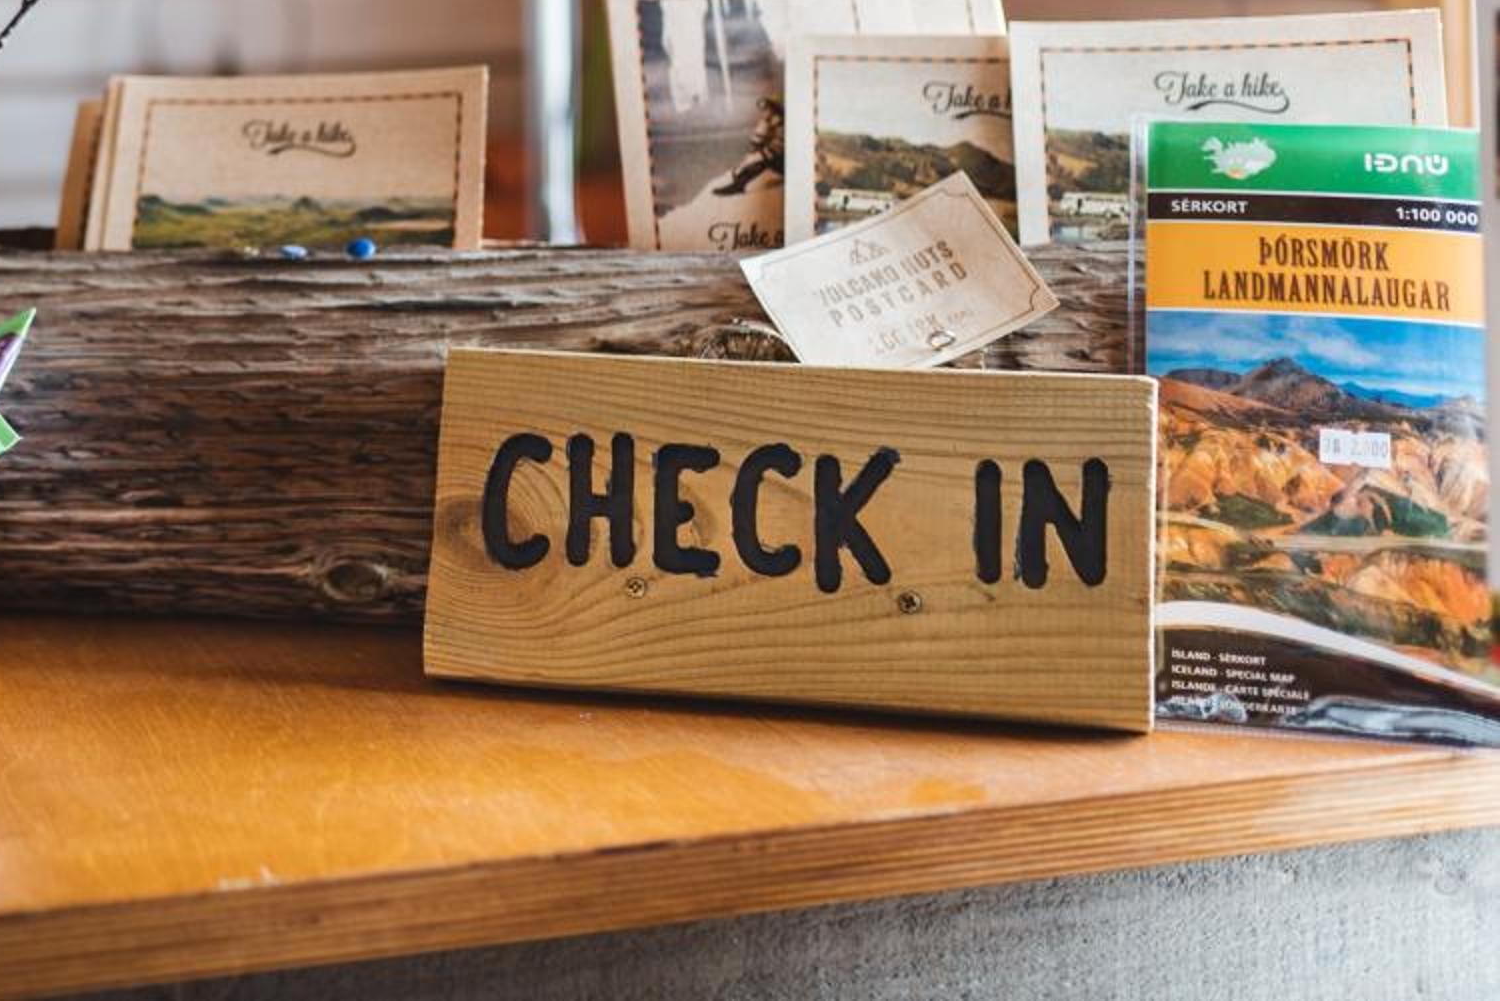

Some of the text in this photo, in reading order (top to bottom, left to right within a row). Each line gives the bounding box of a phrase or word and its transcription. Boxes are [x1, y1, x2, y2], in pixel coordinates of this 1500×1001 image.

[922, 80, 983, 113] Take
[1153, 71, 1288, 105] Take a hike
[1170, 197, 1478, 226] SÉRKORT 1:100 000
[1258, 234, 1390, 272] ÞÓRSMÖRK
[828, 261, 968, 329] POSTCARD
[1202, 269, 1451, 312] LANDMANNALAUGAR
[481, 431, 1112, 593] CHECK IN
